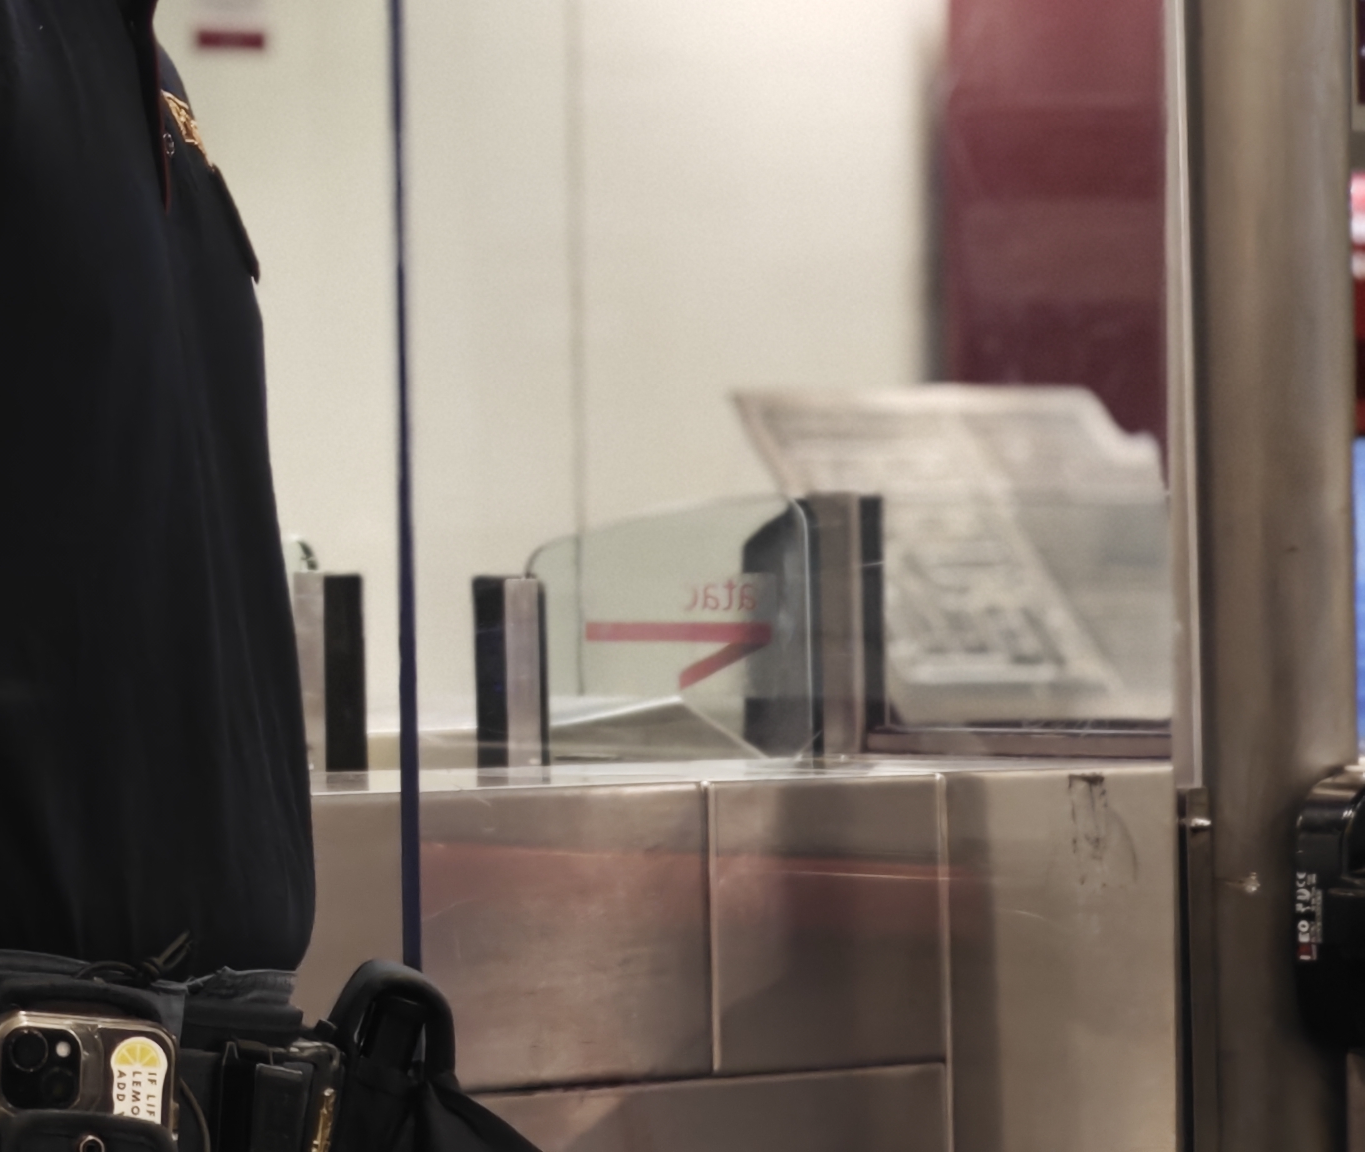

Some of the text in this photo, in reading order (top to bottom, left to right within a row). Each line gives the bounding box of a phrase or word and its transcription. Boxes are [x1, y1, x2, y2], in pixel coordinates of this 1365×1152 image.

[116, 1069, 127, 1102] ADD
[131, 1070, 143, 1116] LEMO
[146, 1072, 158, 1117] IF LIF
